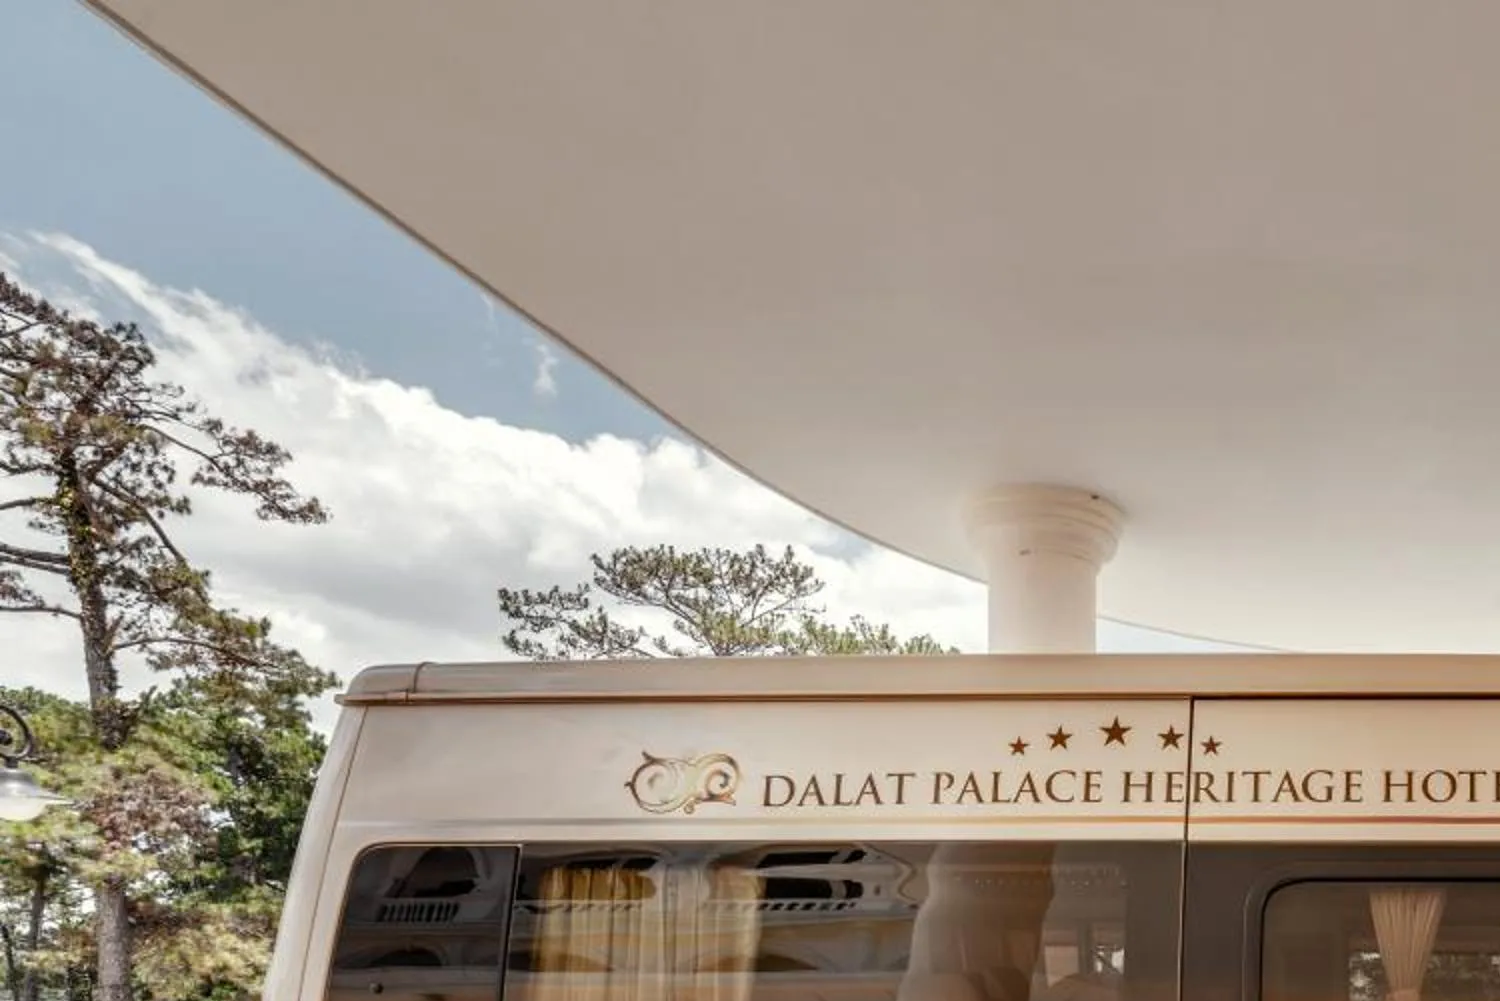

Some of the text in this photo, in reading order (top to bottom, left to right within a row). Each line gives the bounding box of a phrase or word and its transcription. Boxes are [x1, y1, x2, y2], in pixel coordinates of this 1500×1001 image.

[763, 772, 916, 807] DALAT
[932, 769, 1102, 804] PALACE
[1122, 769, 1363, 803] HERITAGE
